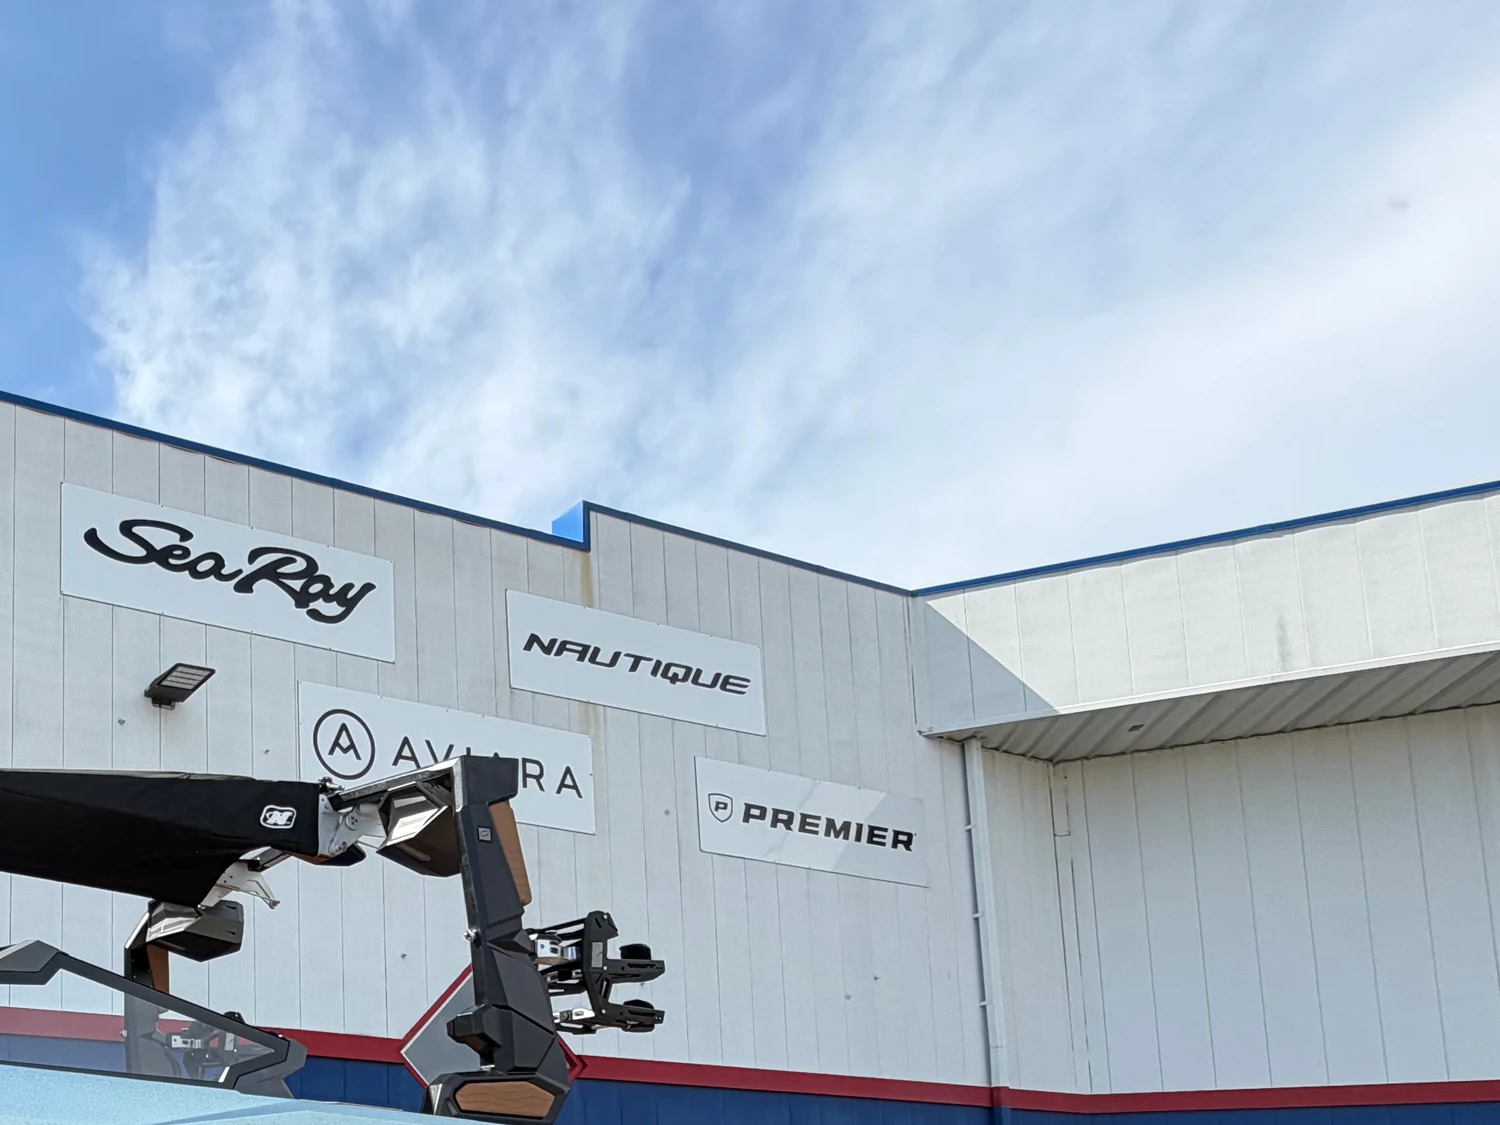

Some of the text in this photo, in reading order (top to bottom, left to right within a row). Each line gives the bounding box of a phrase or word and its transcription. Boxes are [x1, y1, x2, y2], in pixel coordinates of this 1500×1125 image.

[83, 518, 377, 625] Sea Ray
[522, 632, 751, 695] NAUTIQUE
[392, 736, 583, 799] AVRA
[714, 800, 729, 812] P
[742, 802, 915, 852] PREMIER
